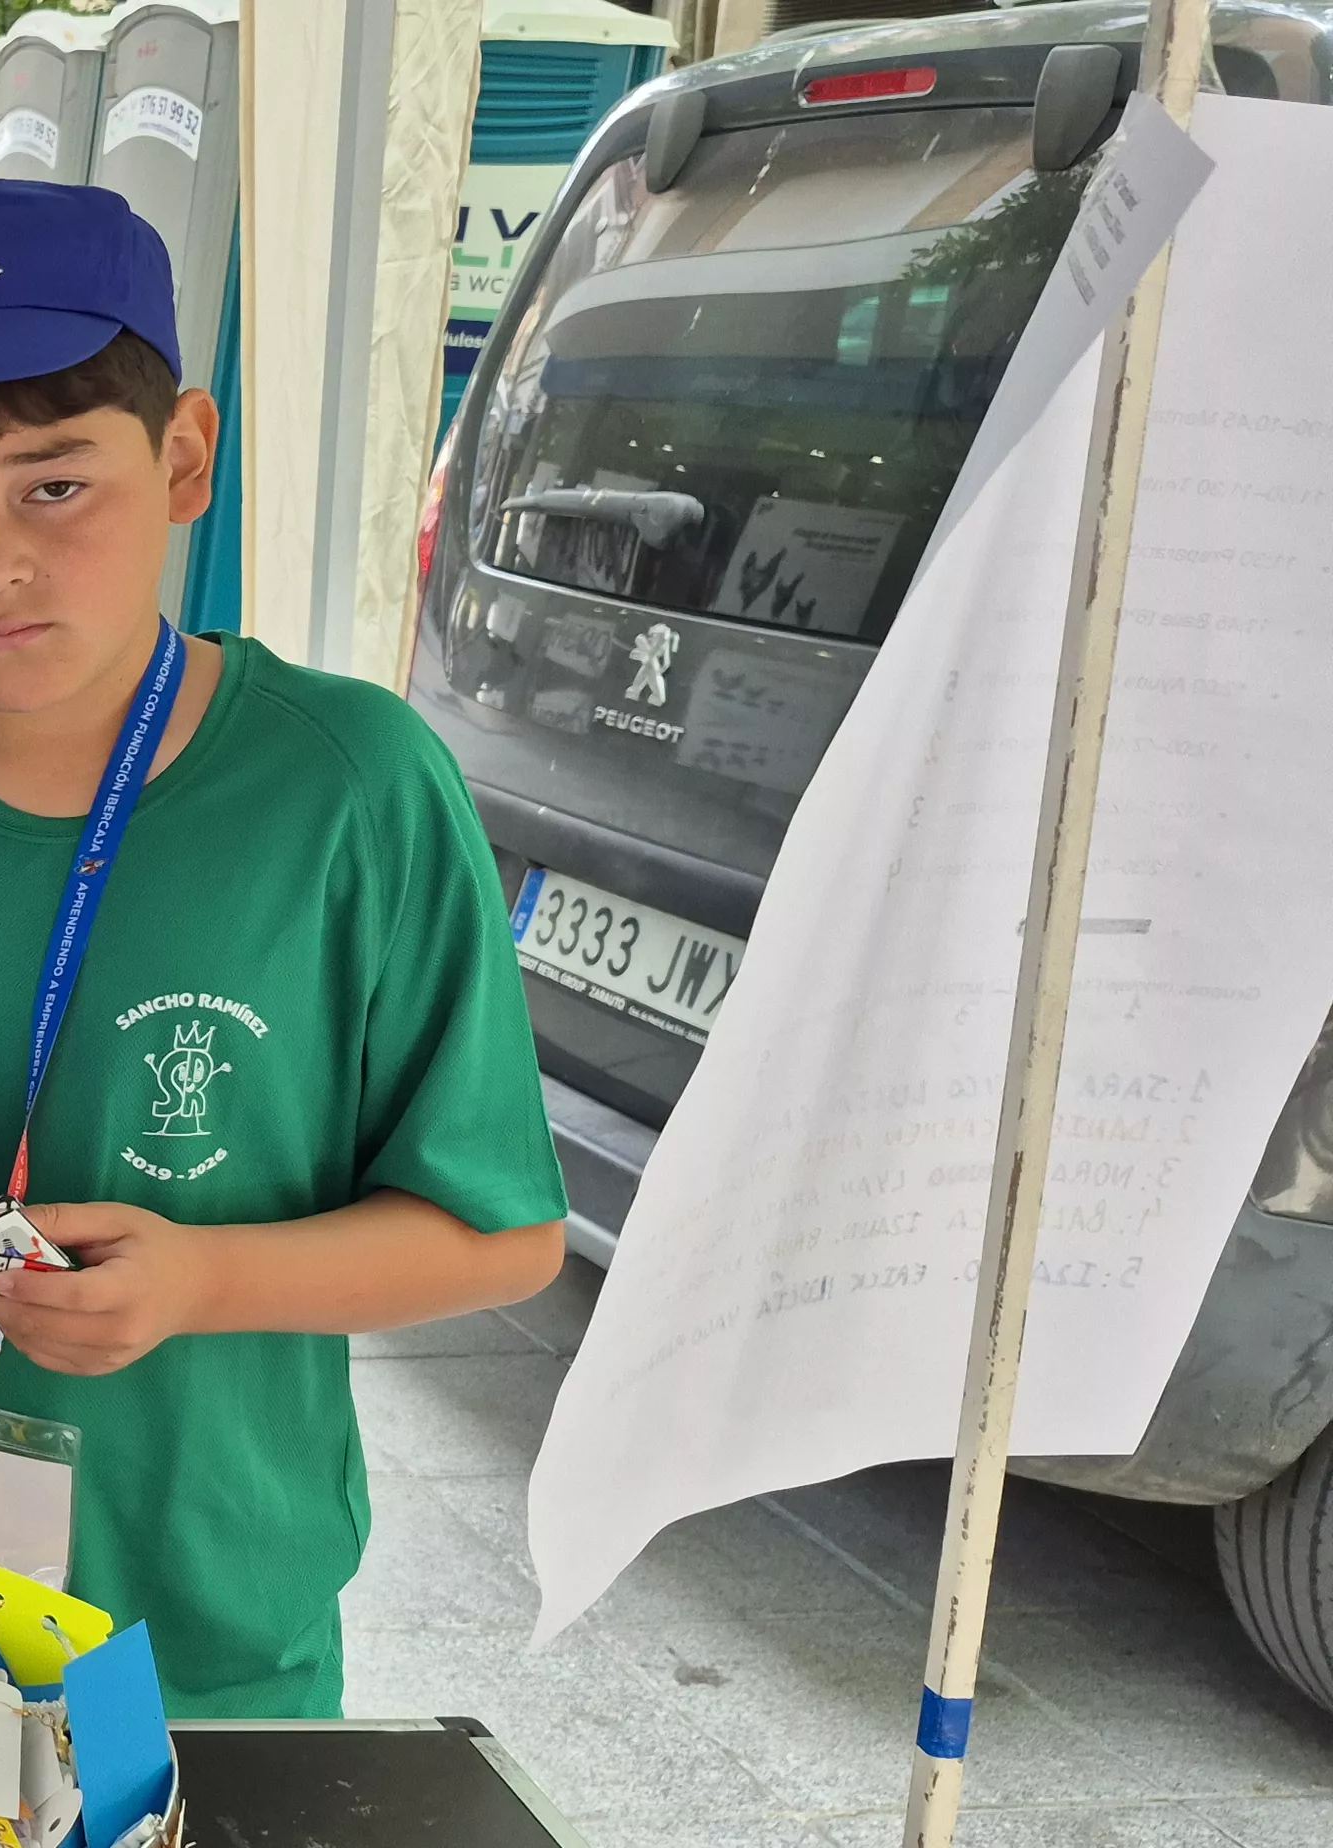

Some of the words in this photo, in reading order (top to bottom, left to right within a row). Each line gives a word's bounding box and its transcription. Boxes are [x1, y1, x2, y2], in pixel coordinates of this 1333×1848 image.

[170, 101, 183, 123] 99
[185, 110, 198, 135] 52
[140, 694, 159, 722] CON
[593, 705, 685, 743] PEUGEOT
[112, 721, 148, 792] FUNDACIÓN
[89, 793, 120, 853] IBERCAJA
[53, 881, 89, 978] APRENDIENDO
[536, 890, 640, 976] 3333
[48, 979, 60, 990] A
[589, 985, 625, 1010] ZARAUTO
[31, 993, 56, 1078] EMPRENDER
[115, 992, 194, 1031] SANCHO
[198, 993, 269, 1039] RAMÍREZ
[120, 1147, 172, 1180] 2019
[188, 1148, 228, 1180] 2026
